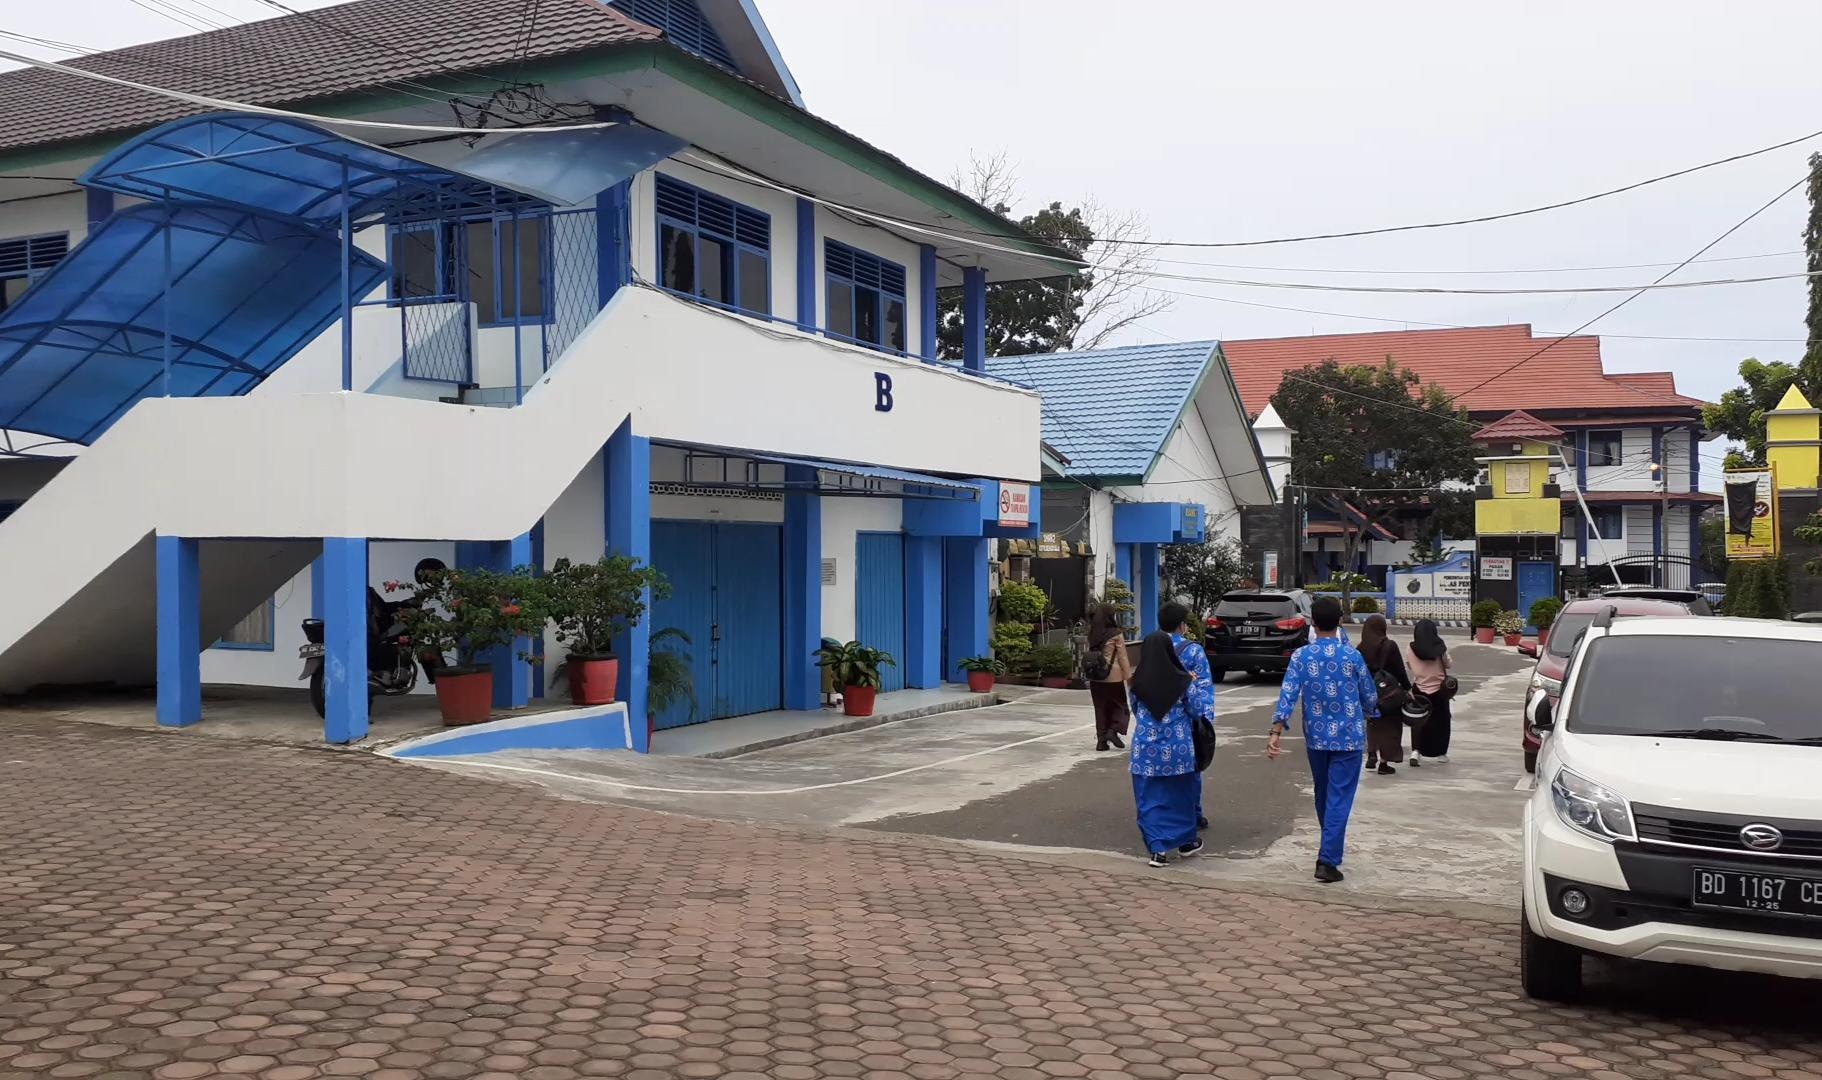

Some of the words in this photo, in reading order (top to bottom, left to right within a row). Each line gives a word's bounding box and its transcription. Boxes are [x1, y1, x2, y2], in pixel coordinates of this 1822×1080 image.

[874, 371, 893, 412] B
[1701, 872, 1726, 895] BD
[1740, 876, 1786, 900] 1167
